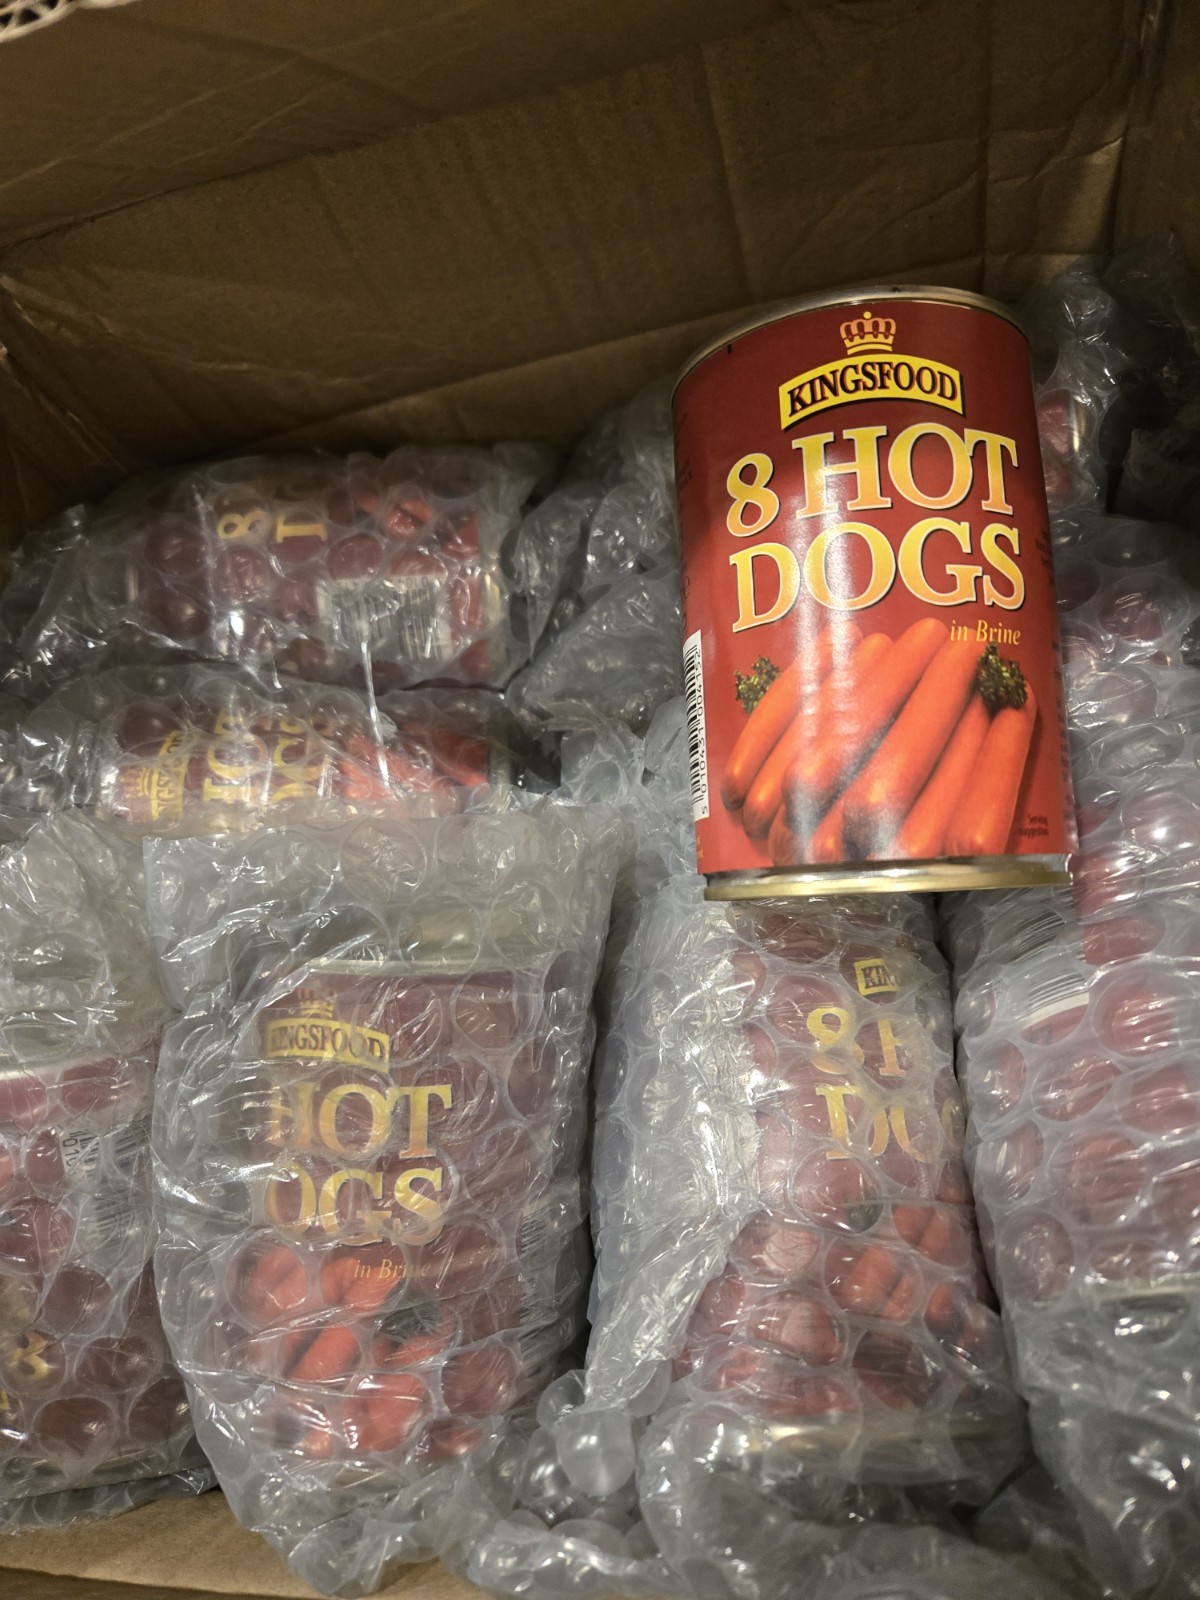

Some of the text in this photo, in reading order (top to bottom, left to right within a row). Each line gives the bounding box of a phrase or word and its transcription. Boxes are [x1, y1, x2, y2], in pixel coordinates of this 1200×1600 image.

[786, 361, 958, 418] KINGSFOOD
[726, 453, 781, 538] 8
[792, 422, 1019, 519] HOT
[729, 516, 1026, 633] DOGS
[949, 620, 1021, 646] in Brine
[694, 647, 709, 815] 5 010431 004152
[264, 1161, 443, 1246] OGS
[353, 1259, 372, 1278] in
